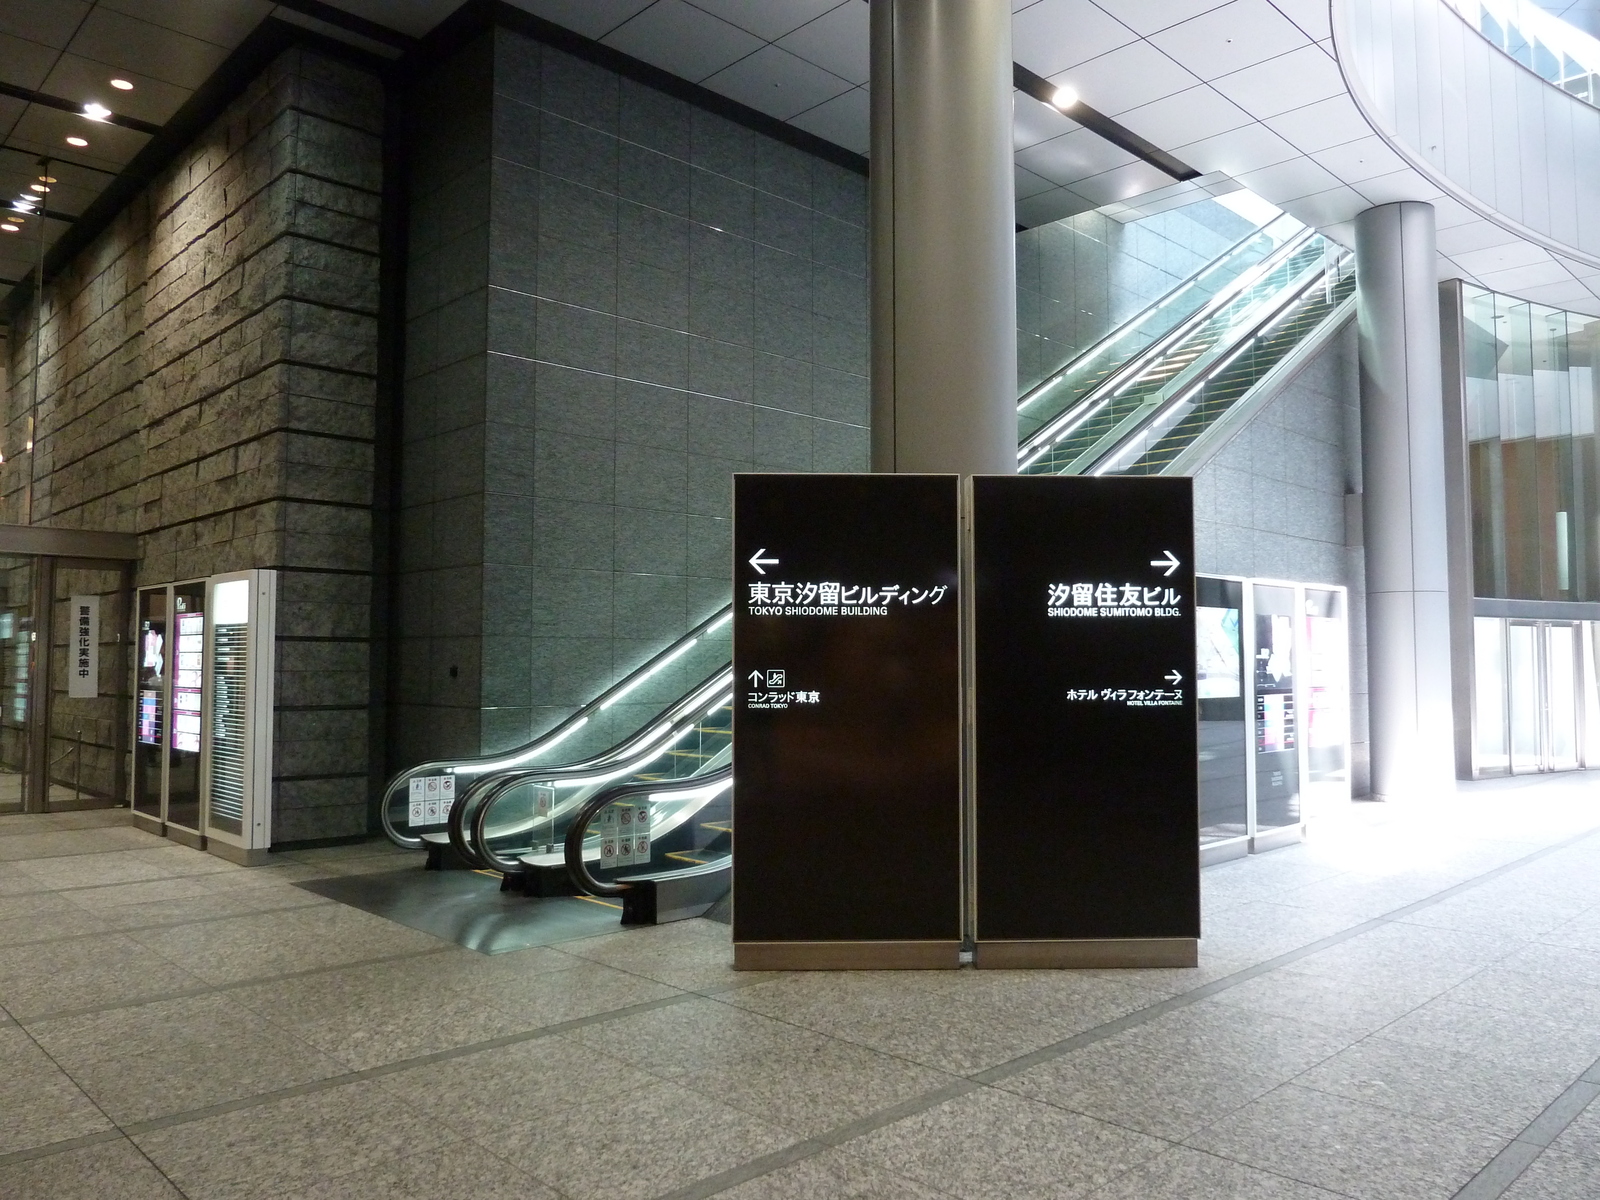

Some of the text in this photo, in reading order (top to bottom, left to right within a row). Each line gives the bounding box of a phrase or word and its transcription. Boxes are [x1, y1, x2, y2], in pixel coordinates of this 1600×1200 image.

[748, 581, 948, 605] 東京汐留ビルディング
[1047, 583, 1182, 607] 汐留住友ビル
[748, 606, 888, 616] TOKYO SHIODOME BUILDING
[1047, 607, 1182, 617] SHIODOME SUMITOMO BLDG.
[79, 606, 90, 678] 警備強化実施中
[748, 690, 820, 703] コンラッド東京
[1066, 689, 1098, 701] ホテル
